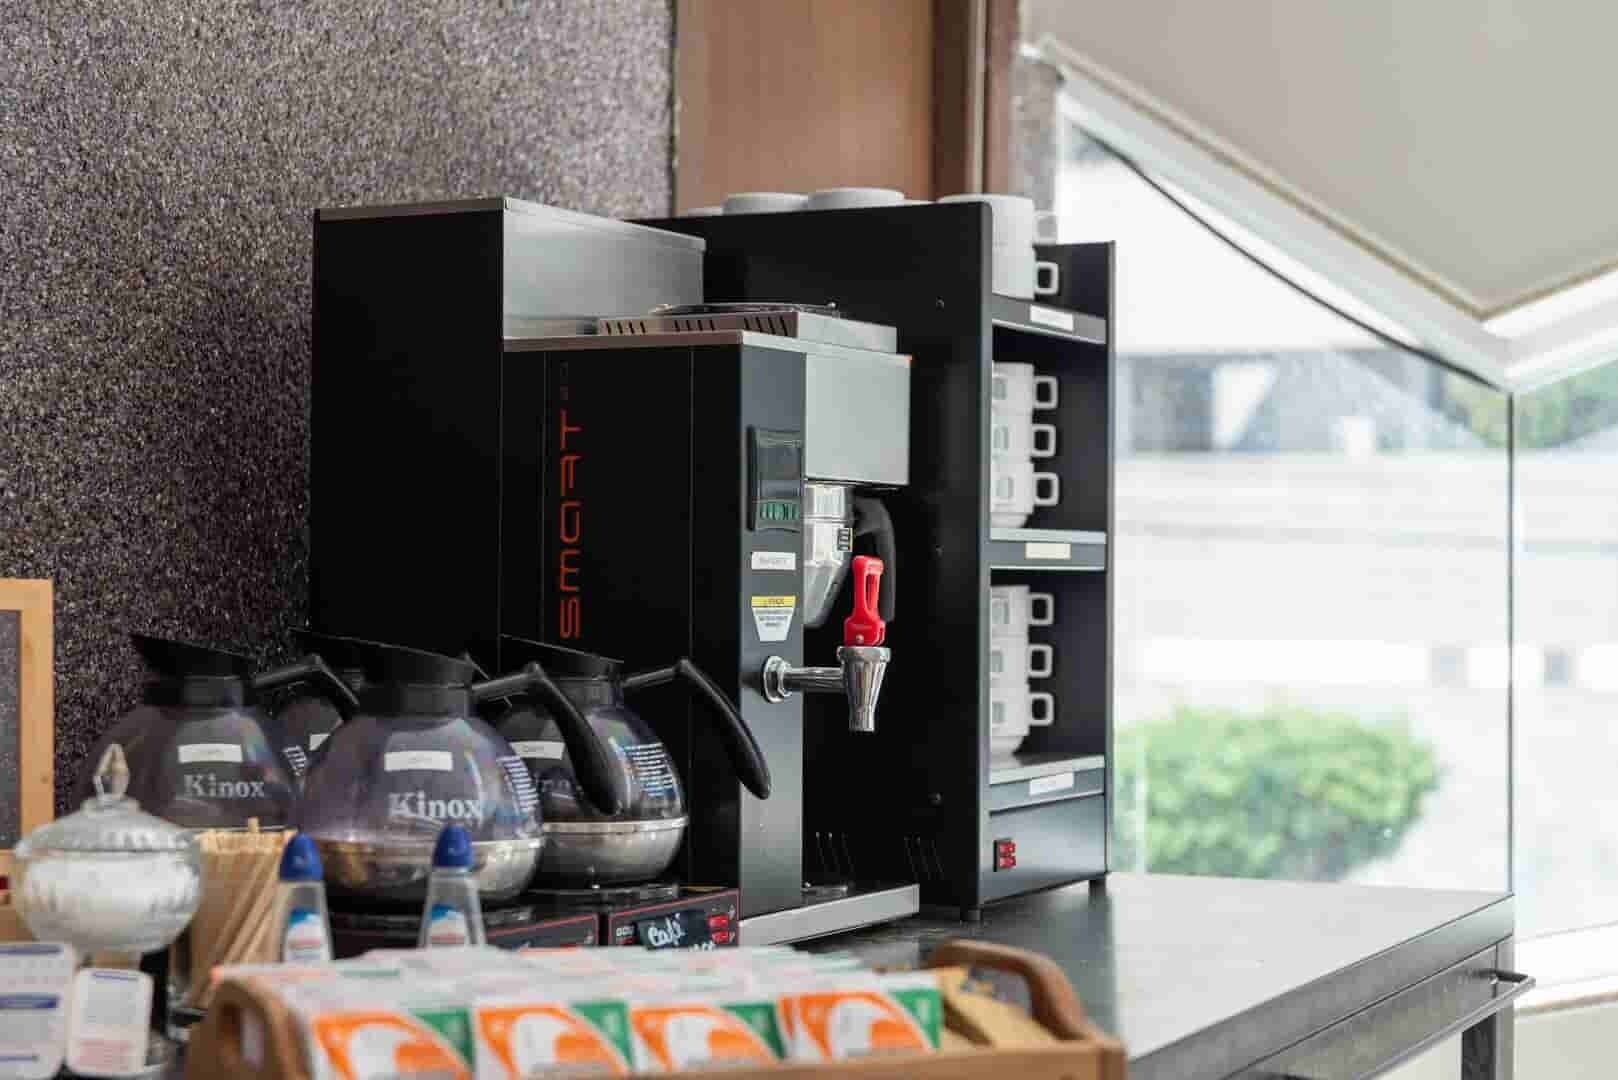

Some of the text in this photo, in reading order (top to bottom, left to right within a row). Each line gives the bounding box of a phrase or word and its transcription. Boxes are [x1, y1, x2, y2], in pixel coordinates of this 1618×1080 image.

[559, 409, 583, 640] SMART
[183, 772, 266, 799] Kinox
[388, 790, 484, 820] Kinox
